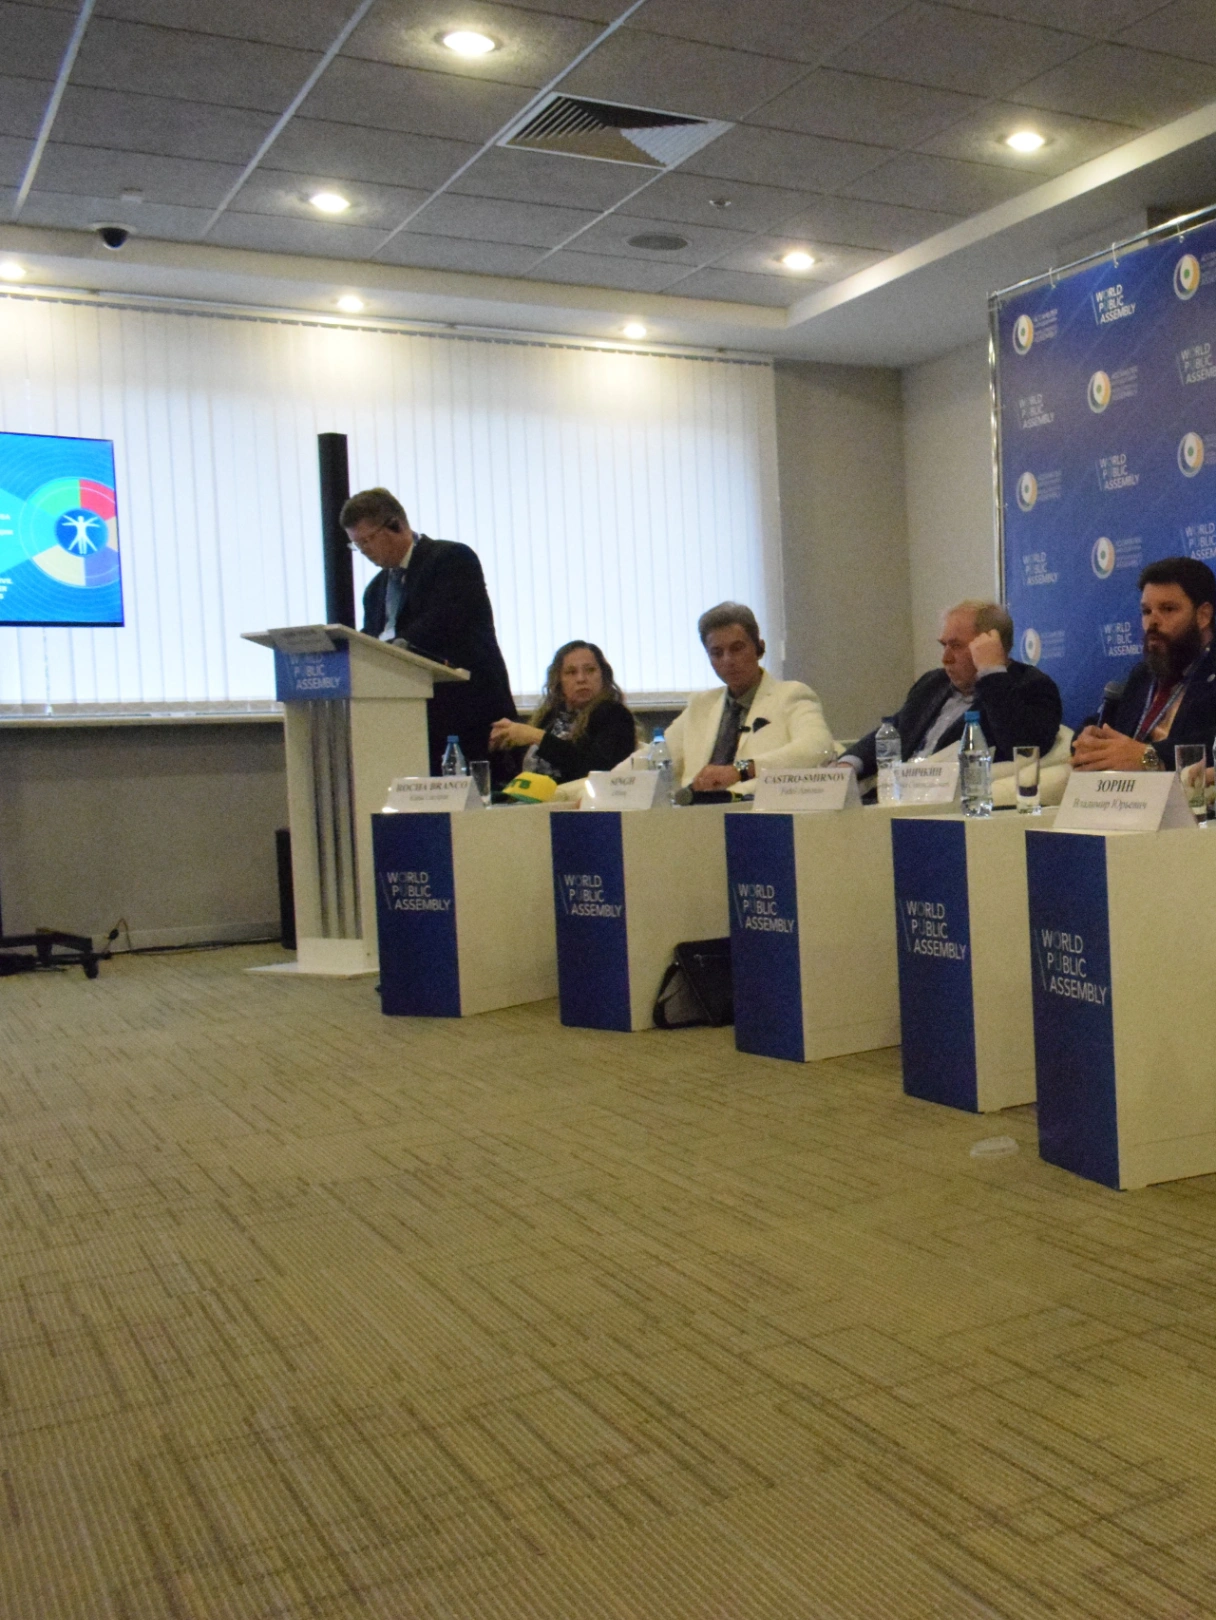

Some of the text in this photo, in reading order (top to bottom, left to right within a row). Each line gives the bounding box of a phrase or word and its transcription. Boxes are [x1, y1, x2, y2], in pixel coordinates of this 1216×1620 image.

[1096, 779, 1136, 793] ЗОРИН
[387, 871, 429, 884] WORLD
[564, 874, 602, 888] WORLD
[392, 885, 431, 897] PUBLIC
[569, 888, 604, 902] PUBLIC
[738, 883, 775, 899] WORLD
[394, 898, 450, 911] ASSEMBLY
[571, 903, 622, 918] ASSEMBLY
[743, 899, 777, 916] PUBLIC
[906, 900, 945, 919] WORLD
[745, 916, 794, 934] ASSEMBLY
[911, 919, 948, 939] PUBLIC
[914, 938, 967, 961] ASSEMBLY
[1041, 929, 1084, 954] WORLD
[1047, 952, 1087, 978] PUBLIC
[1049, 975, 1107, 1006] ASSEMBLY
